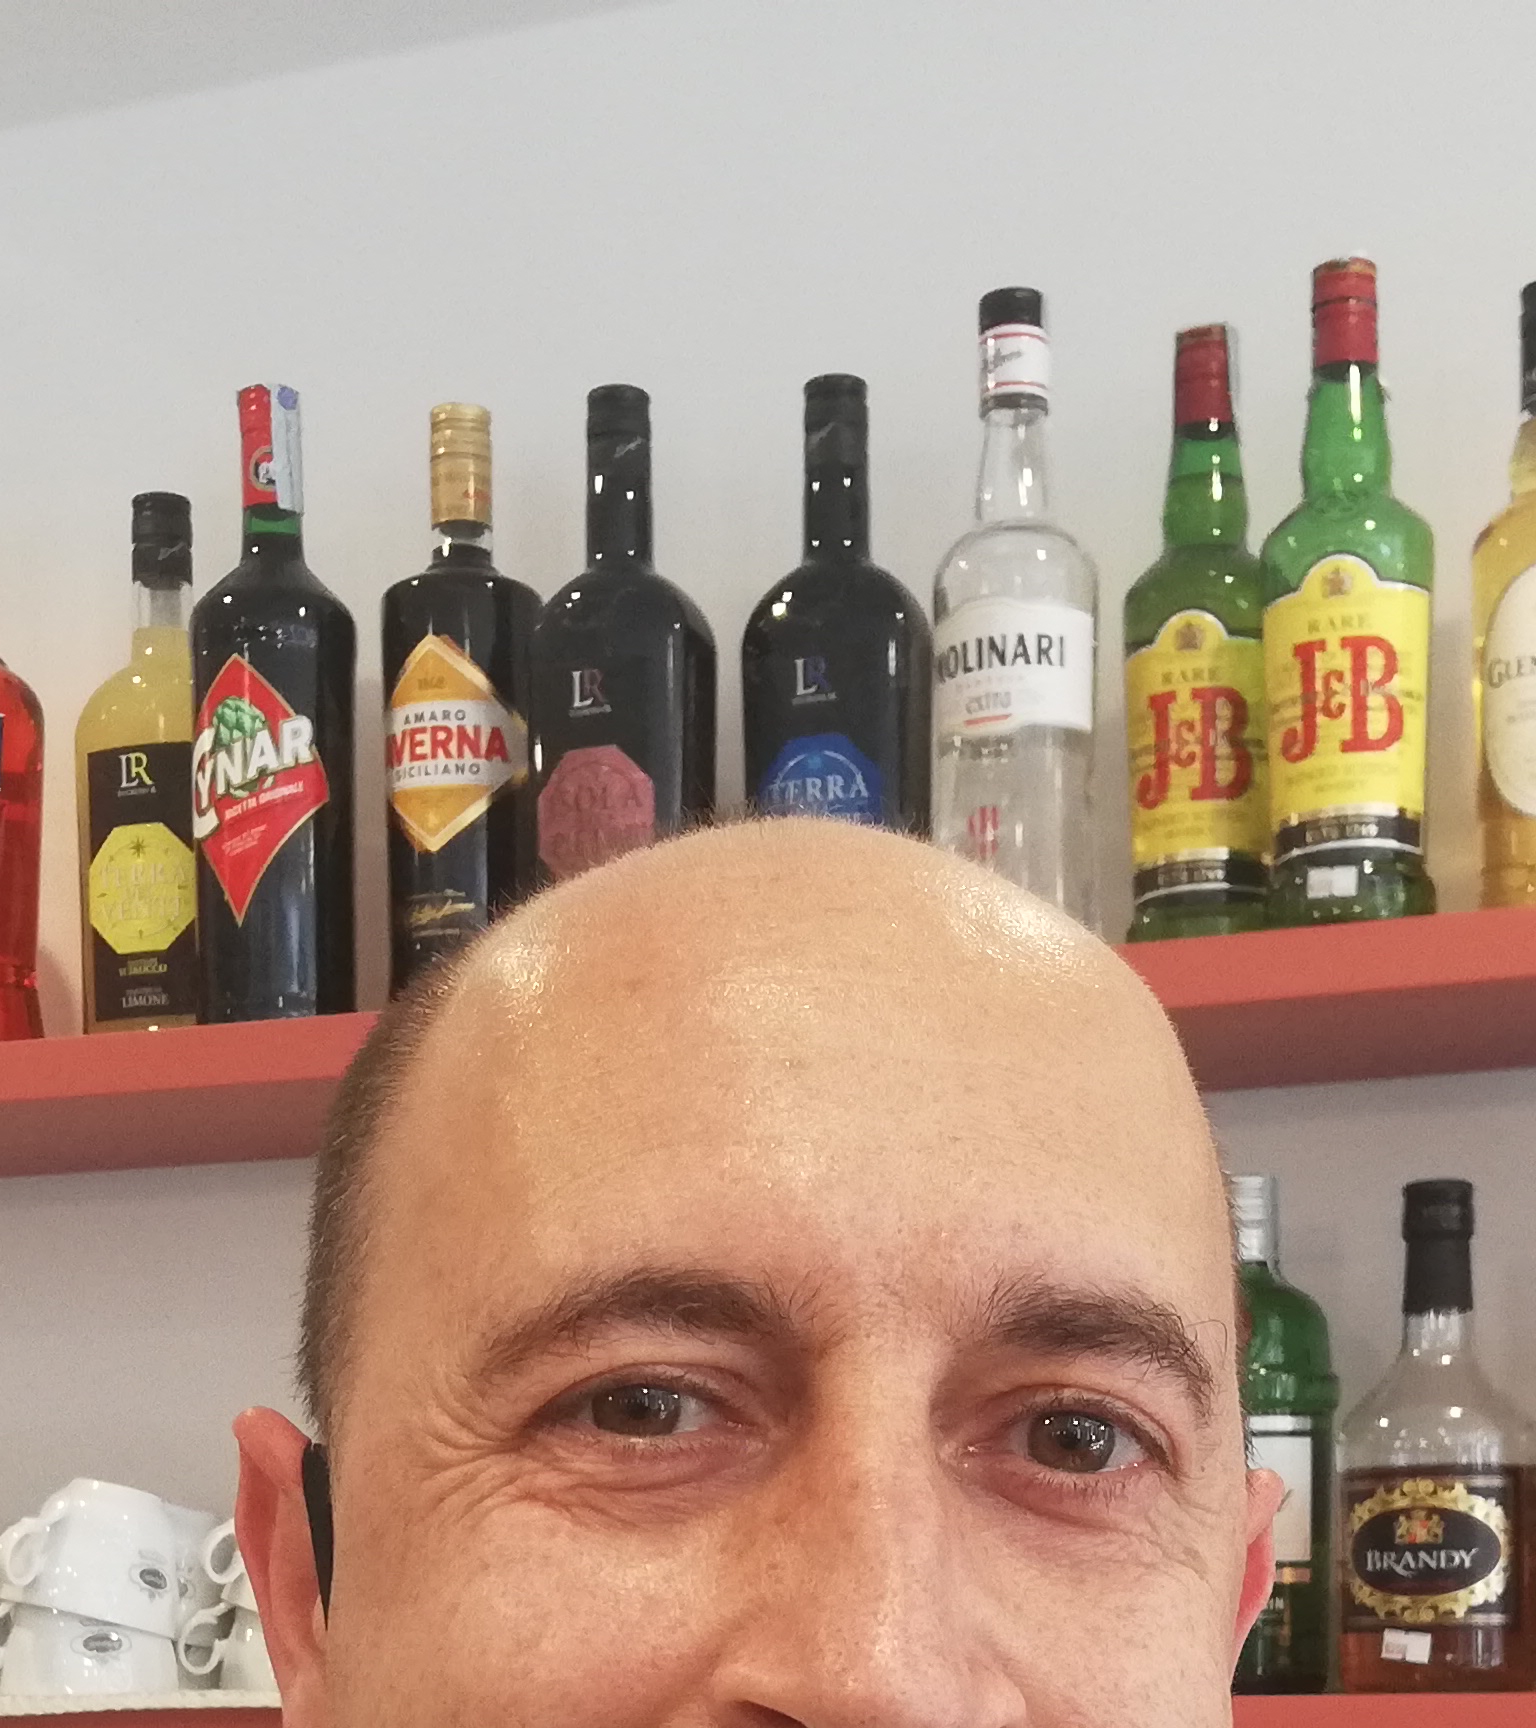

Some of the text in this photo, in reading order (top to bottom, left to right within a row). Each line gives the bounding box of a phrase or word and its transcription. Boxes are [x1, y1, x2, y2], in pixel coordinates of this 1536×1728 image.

[1281, 635, 1404, 763] J&B
[404, 709, 466, 725] AMARO
[192, 715, 314, 839] CYNAR
[395, 763, 480, 782] SICILIANO
[1366, 1547, 1479, 1578] BRANDY
